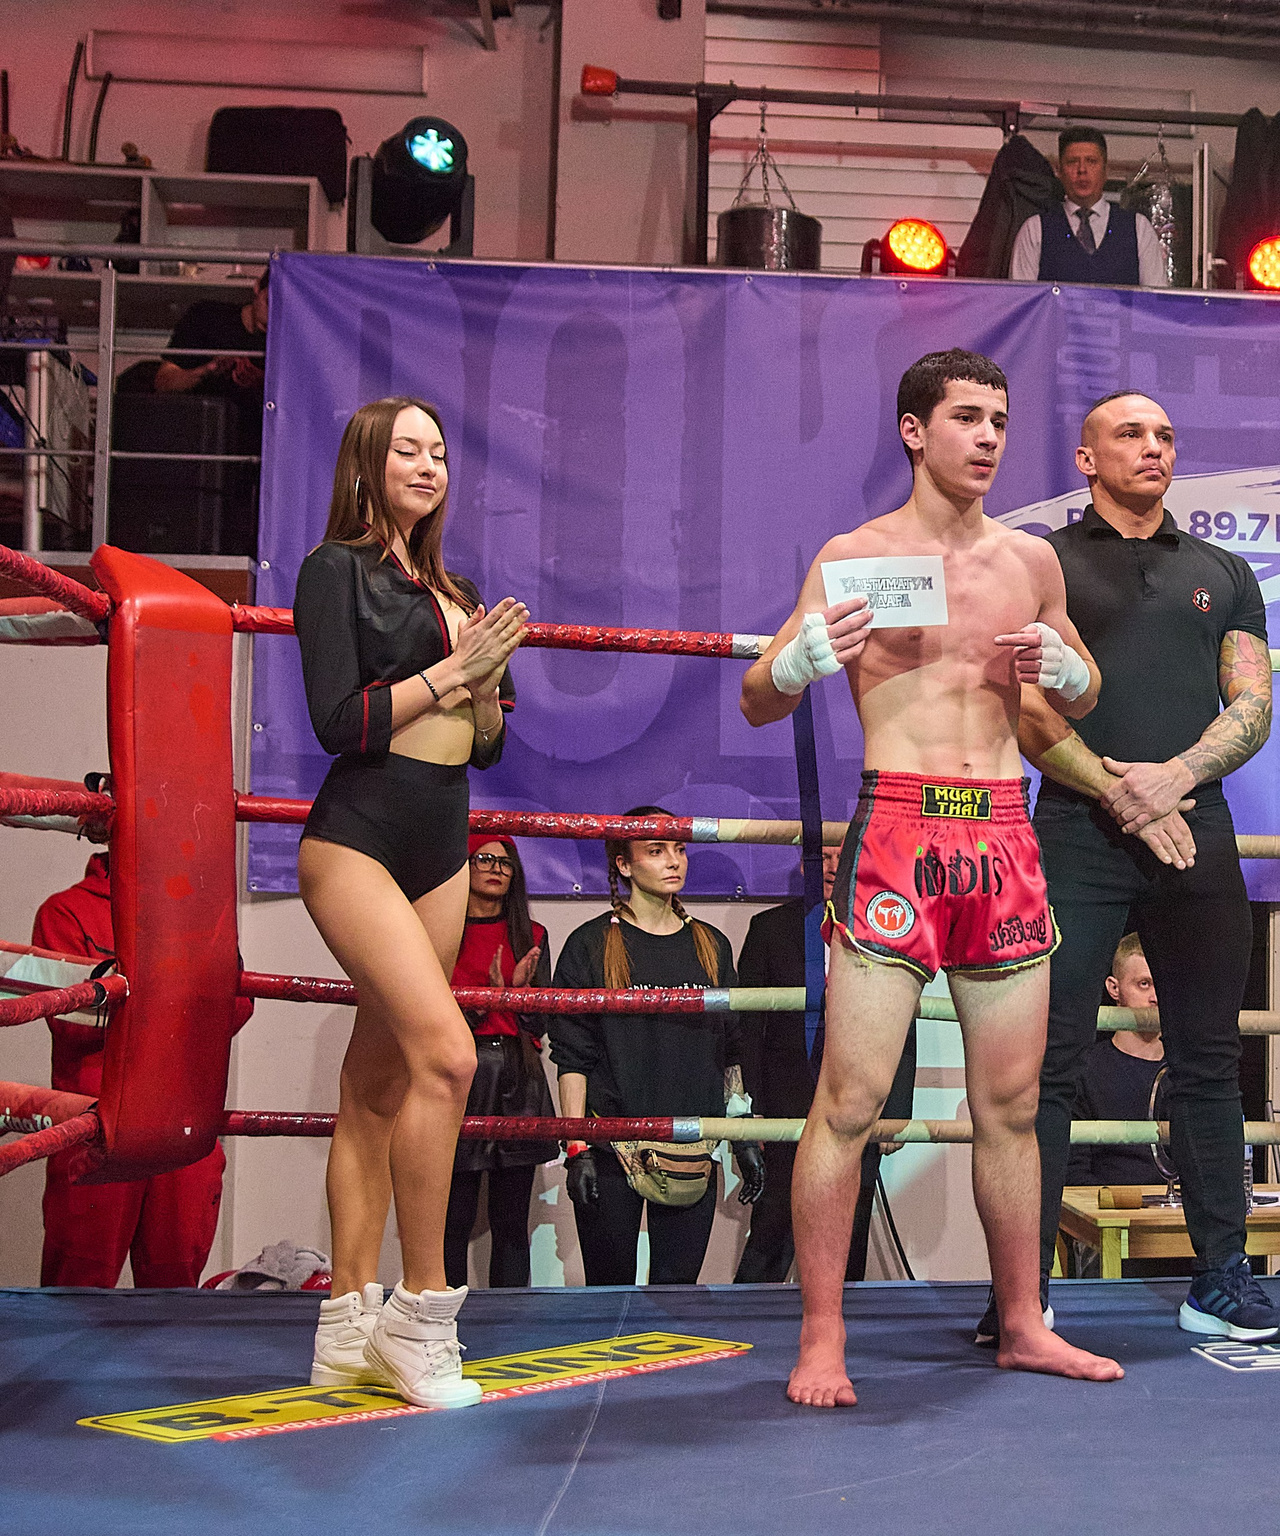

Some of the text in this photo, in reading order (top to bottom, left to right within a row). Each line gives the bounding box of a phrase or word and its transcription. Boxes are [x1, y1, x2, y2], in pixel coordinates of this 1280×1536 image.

[1189, 510, 1271, 541] 89.7
[840, 576, 934, 593] УЛЬТИМАТУМ
[866, 592, 912, 610] УДАРА
[934, 787, 983, 804] MUAY
[936, 801, 979, 816] THAI
[510, 1367, 630, 1394] ГОНОЧНАЯ
[634, 1351, 739, 1372] КОМАНДА
